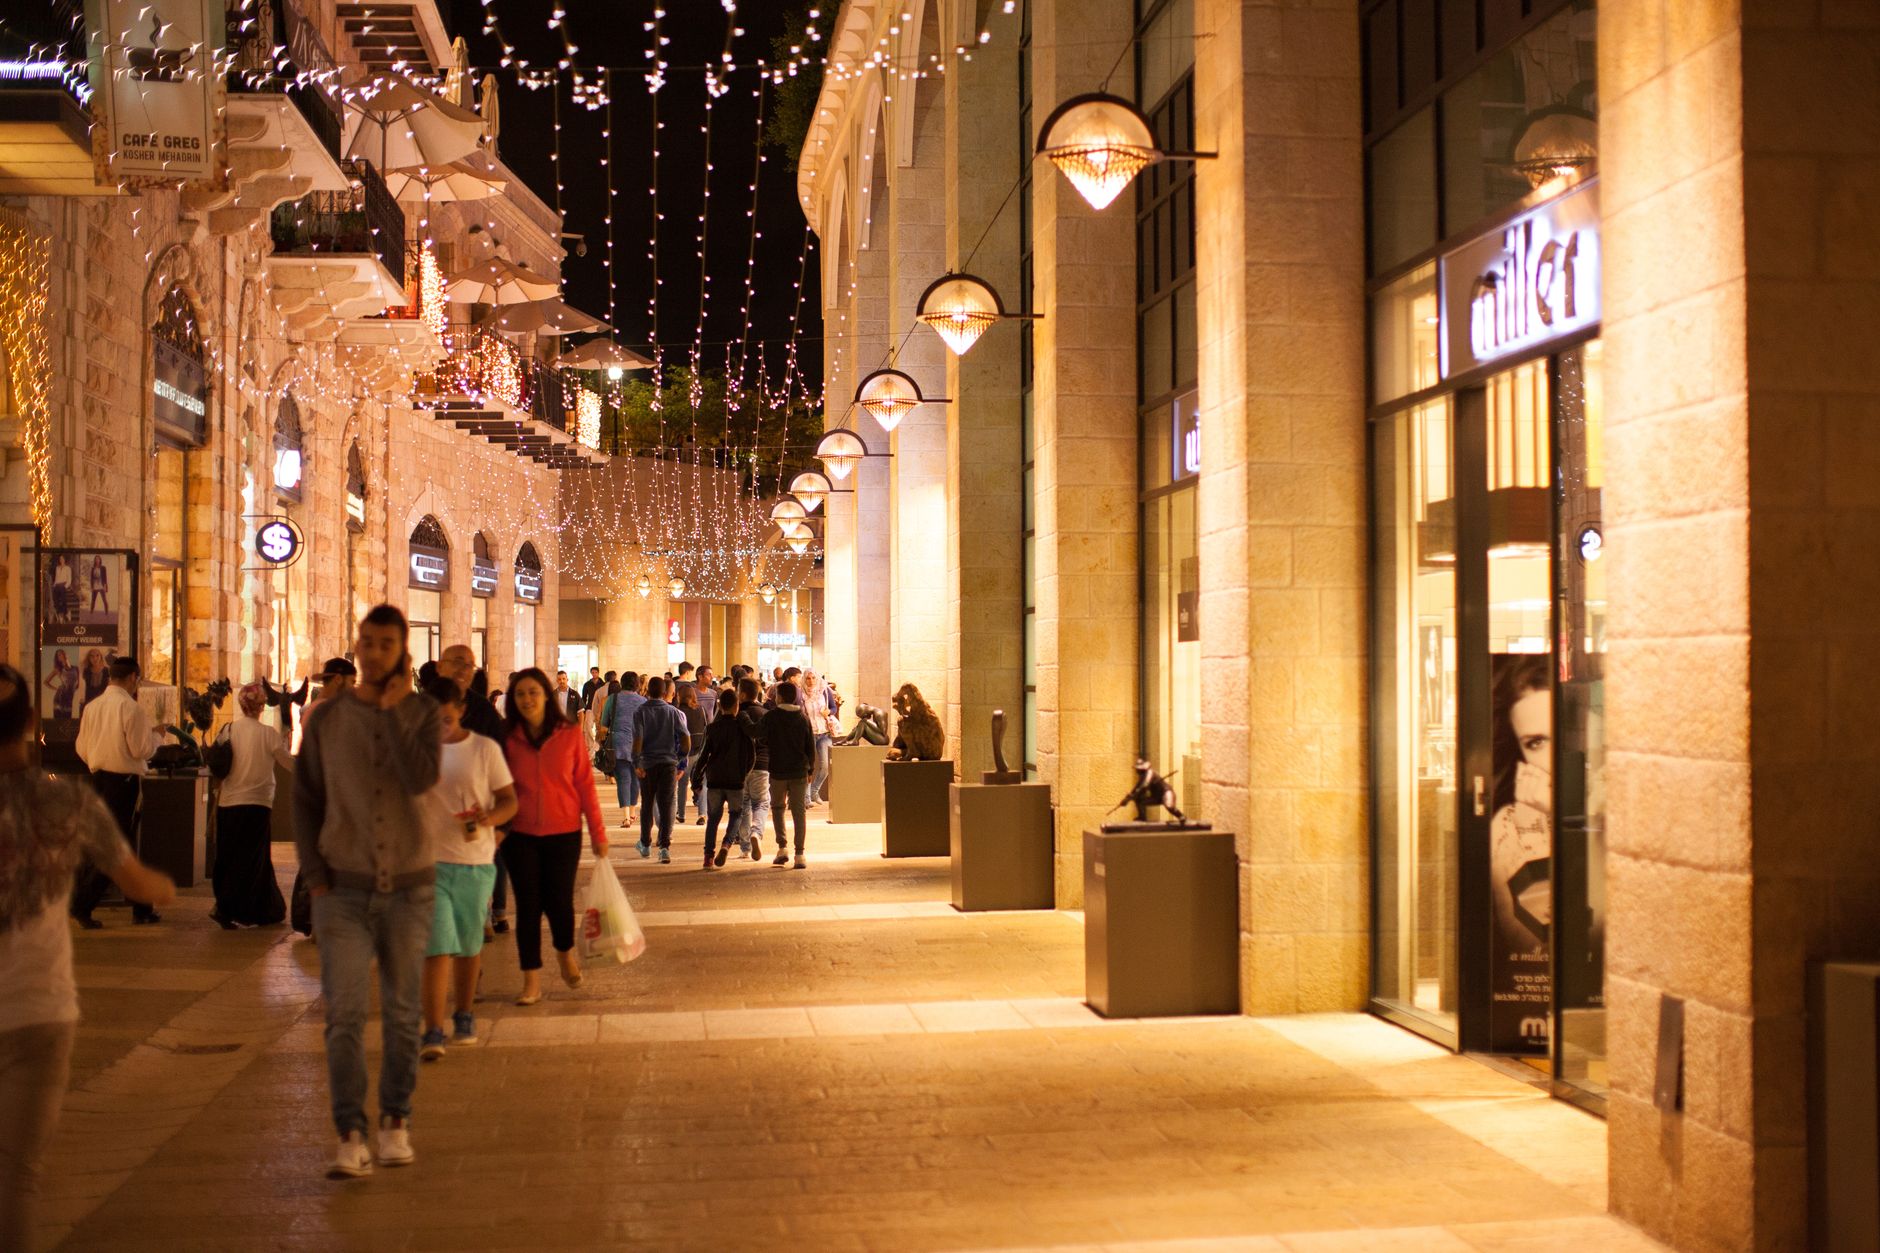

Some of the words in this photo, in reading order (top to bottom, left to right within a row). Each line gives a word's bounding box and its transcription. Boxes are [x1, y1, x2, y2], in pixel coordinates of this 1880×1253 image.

[163, 135, 200, 150] GREG
[122, 149, 155, 161] KOSHER
[158, 150, 201, 163] MEHADRIN
[262, 523, 292, 561] $
[56, 636, 79, 644] GERRY
[79, 636, 103, 644] WEBER
